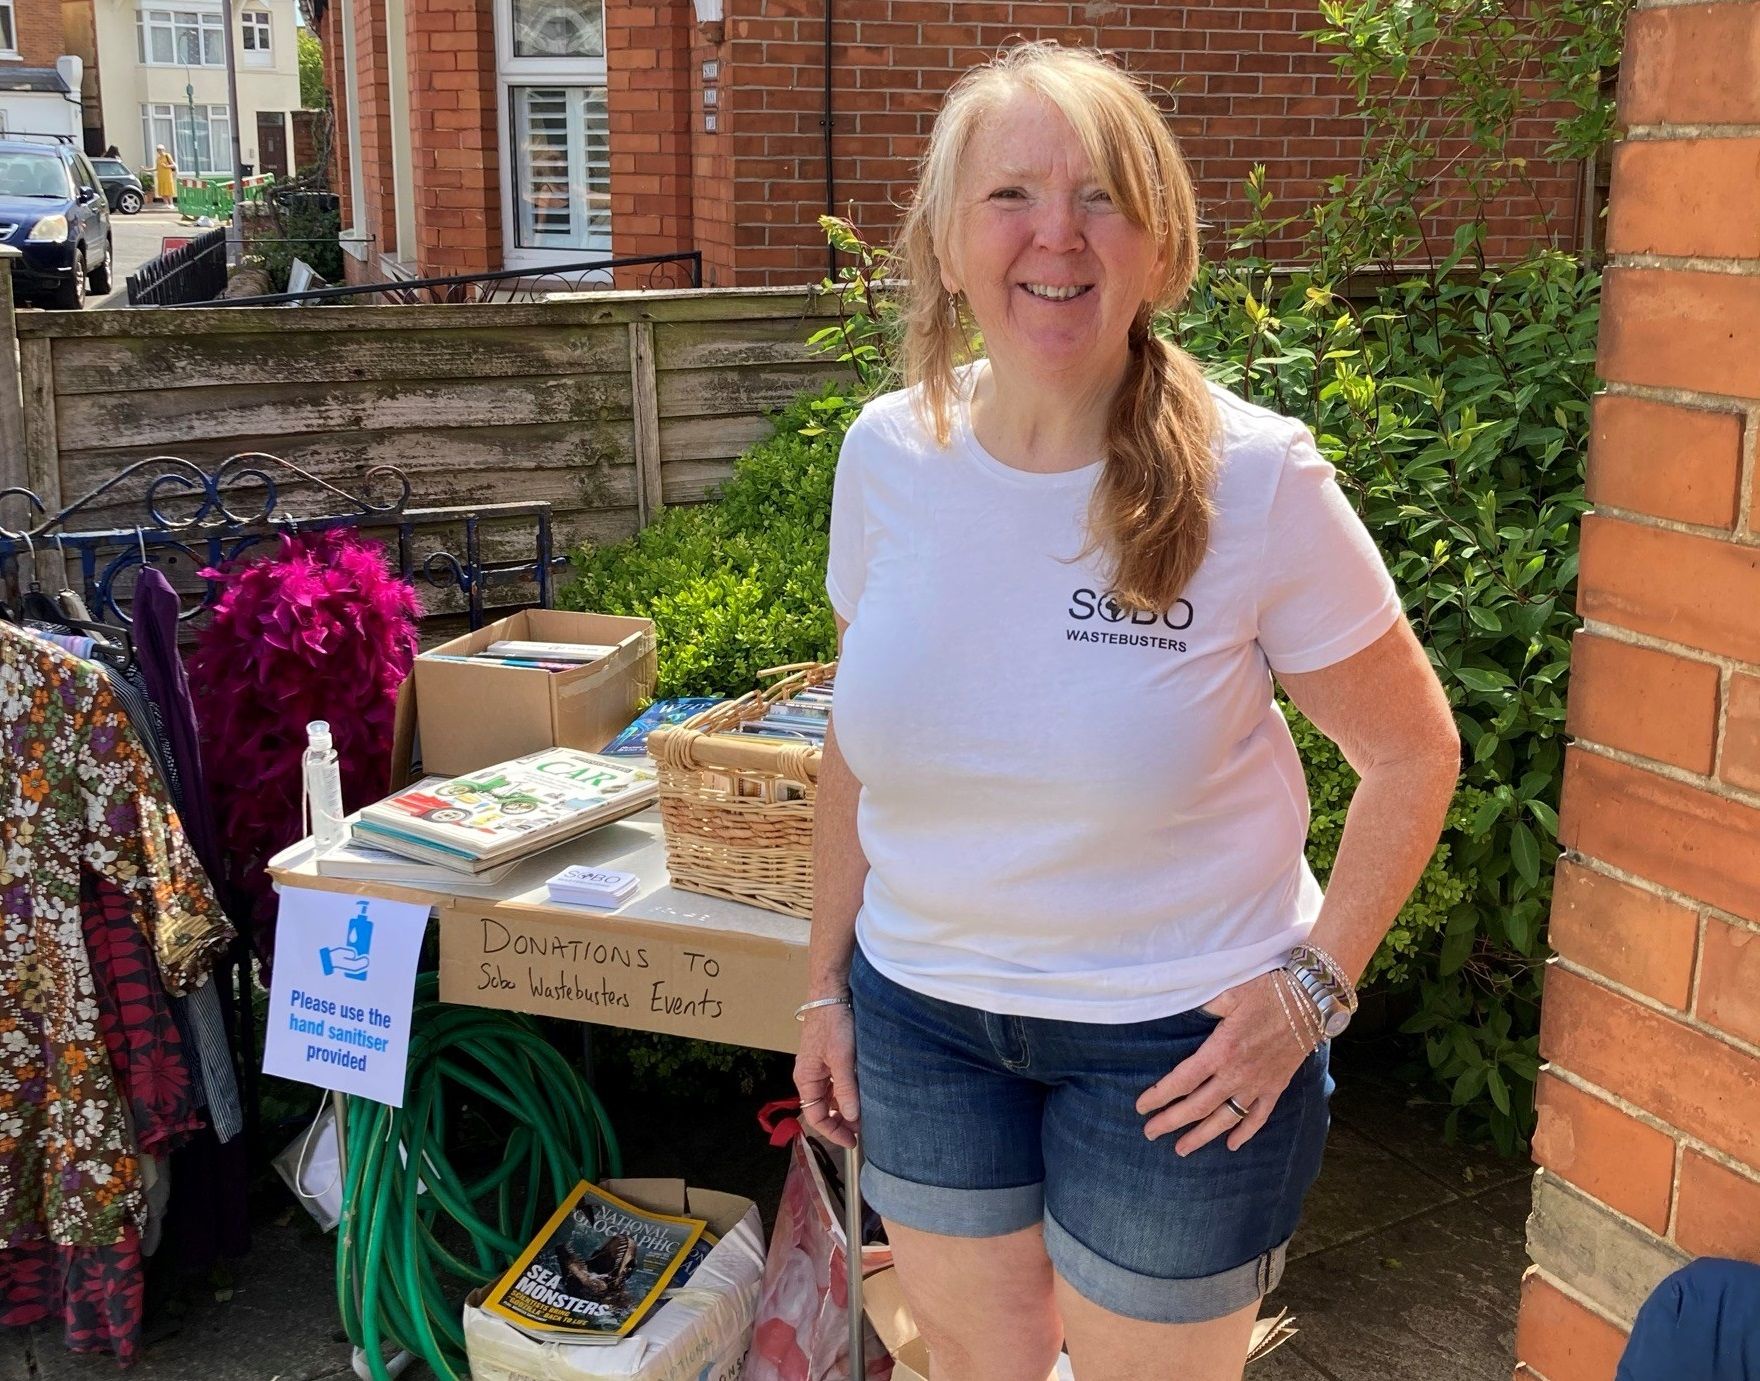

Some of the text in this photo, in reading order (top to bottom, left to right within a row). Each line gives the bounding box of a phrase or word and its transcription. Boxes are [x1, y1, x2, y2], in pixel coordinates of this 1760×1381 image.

[1066, 629, 1187, 652] WASTEBUSTERS
[537, 762, 617, 786] CAR
[480, 918, 720, 978] DONATIONS TO
[478, 963, 722, 1018] Sobo Wastebusters Events
[291, 990, 391, 1029] Please use the
[289, 1013, 389, 1052] hand sanitiser
[306, 1045, 367, 1072] provided
[594, 1205, 669, 1240] NATIONAL
[526, 1264, 562, 1290] SEA
[515, 1276, 610, 1317] MONSTERS
